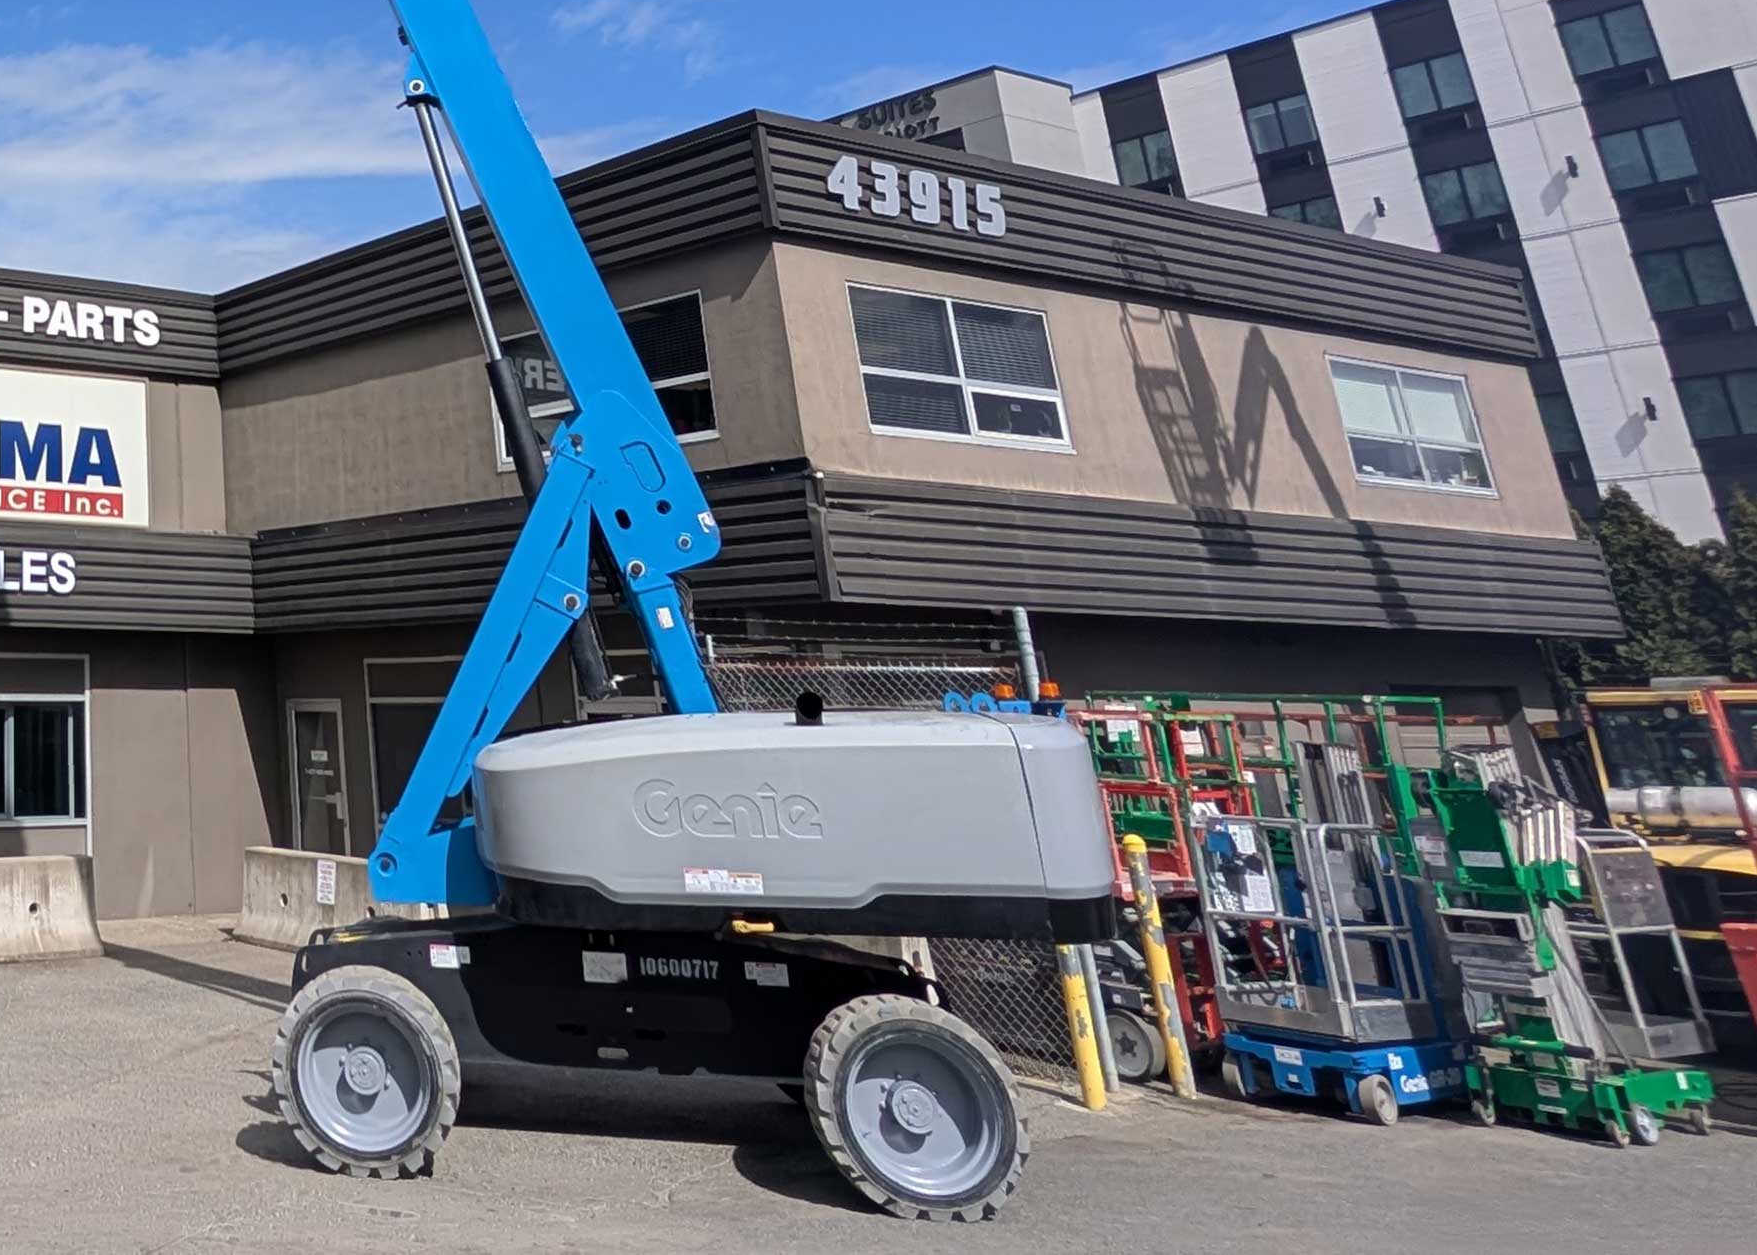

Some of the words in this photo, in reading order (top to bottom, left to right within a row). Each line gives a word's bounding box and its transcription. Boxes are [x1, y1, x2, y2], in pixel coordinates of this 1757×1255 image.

[855, 89, 937, 130] SUITES
[827, 155, 1006, 237] 43915
[23, 296, 161, 346] PARTS
[64, 492, 120, 516] Inc.
[633, 778, 824, 838] Genie
[639, 955, 720, 980] 10600717
